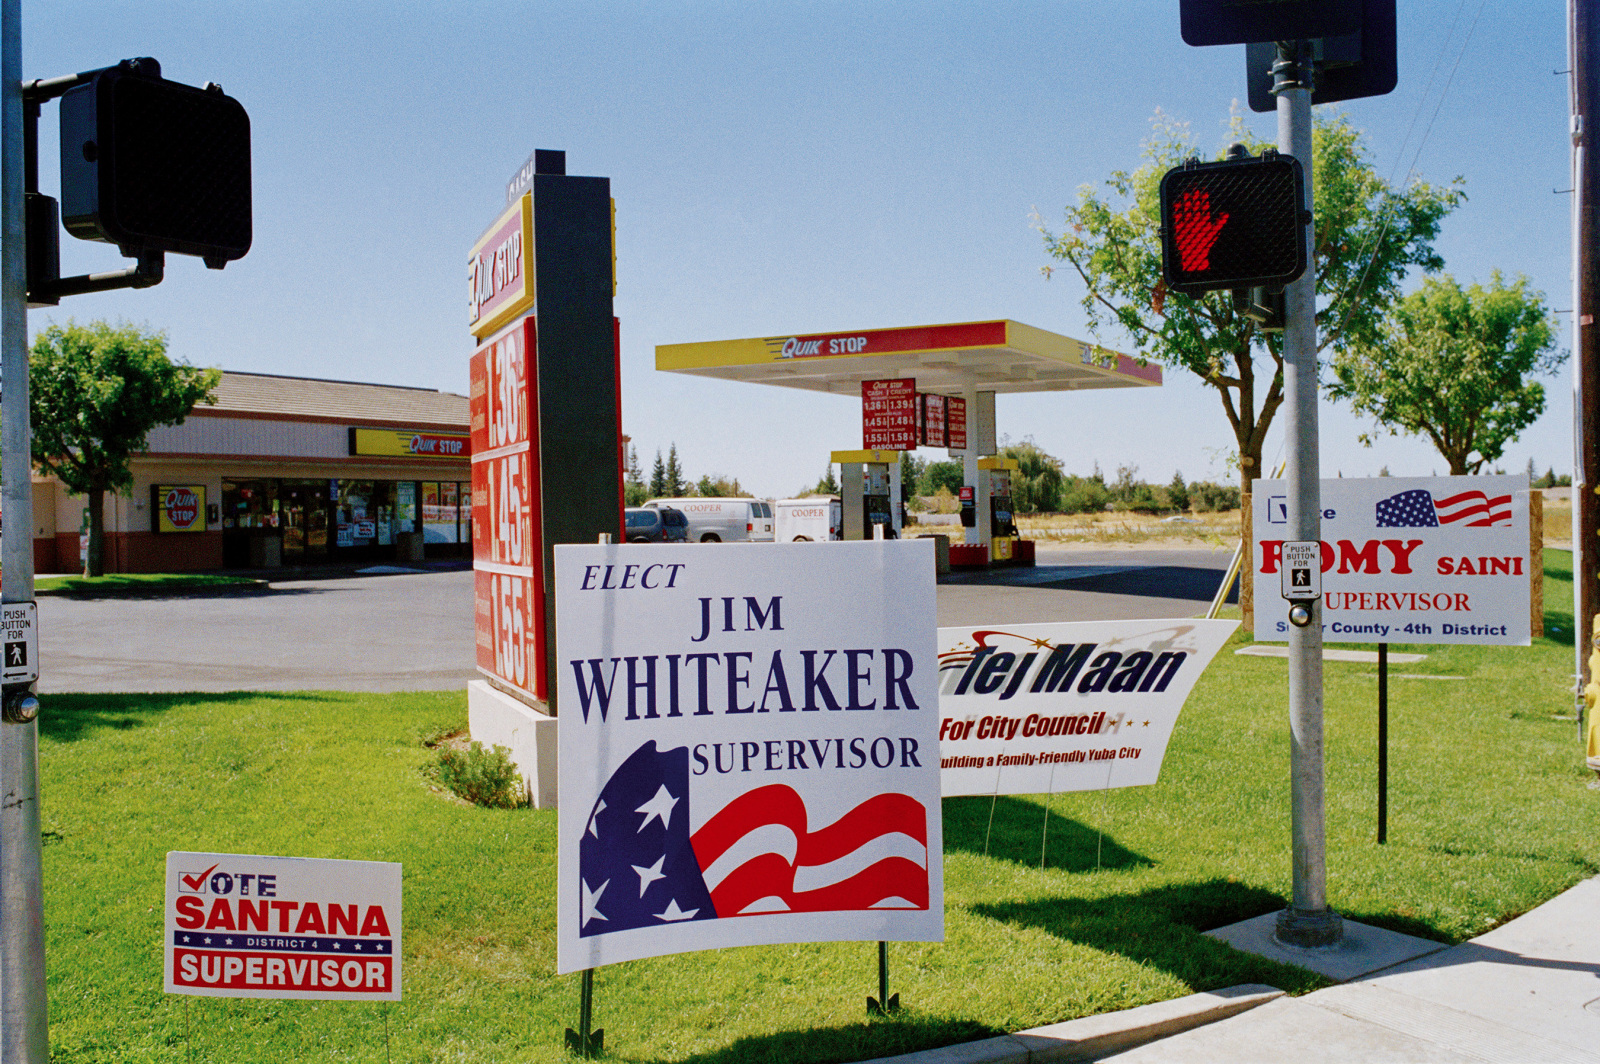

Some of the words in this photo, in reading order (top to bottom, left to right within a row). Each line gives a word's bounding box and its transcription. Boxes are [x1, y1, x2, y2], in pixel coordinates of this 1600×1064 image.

[497, 230, 520, 291] STOP
[781, 337, 823, 358] QUIK
[829, 337, 867, 354] STOP
[410, 435, 438, 454] QUIK
[440, 440, 462, 454] STOP
[166, 490, 198, 508] QUIK
[684, 504, 722, 512] COOPER
[172, 510, 194, 521] STOP
[792, 509, 824, 518] COOPER
[1437, 556, 1524, 576] SAINI
[580, 564, 686, 590] ELECT
[1325, 592, 1472, 611] UPERVISOR
[4, 610, 26, 620] PUSH
[691, 596, 785, 642] JIM
[8, 630, 24, 640] FOR
[491, 574, 524, 686] 1.55
[1332, 622, 1390, 636] County
[1404, 622, 1432, 635] 4th
[1442, 623, 1507, 636] District
[954, 646, 1038, 700] Tej
[1030, 643, 1188, 693] Maan
[570, 648, 920, 725] WHITEAKER
[939, 718, 975, 741] For
[977, 714, 1020, 741] City
[1022, 712, 1106, 738] Council
[692, 736, 922, 776] SUPERVISOR
[940, 756, 984, 769] uilding
[986, 757, 994, 766] a
[996, 750, 1086, 767] Family-Friendly
[1088, 748, 1118, 762] Yuba
[1118, 747, 1142, 760] City
[176, 896, 391, 936] SANTANA
[246, 938, 306, 948] DISTRICT
[312, 940, 318, 949] 4
[180, 954, 386, 988] SUPERVISOR
